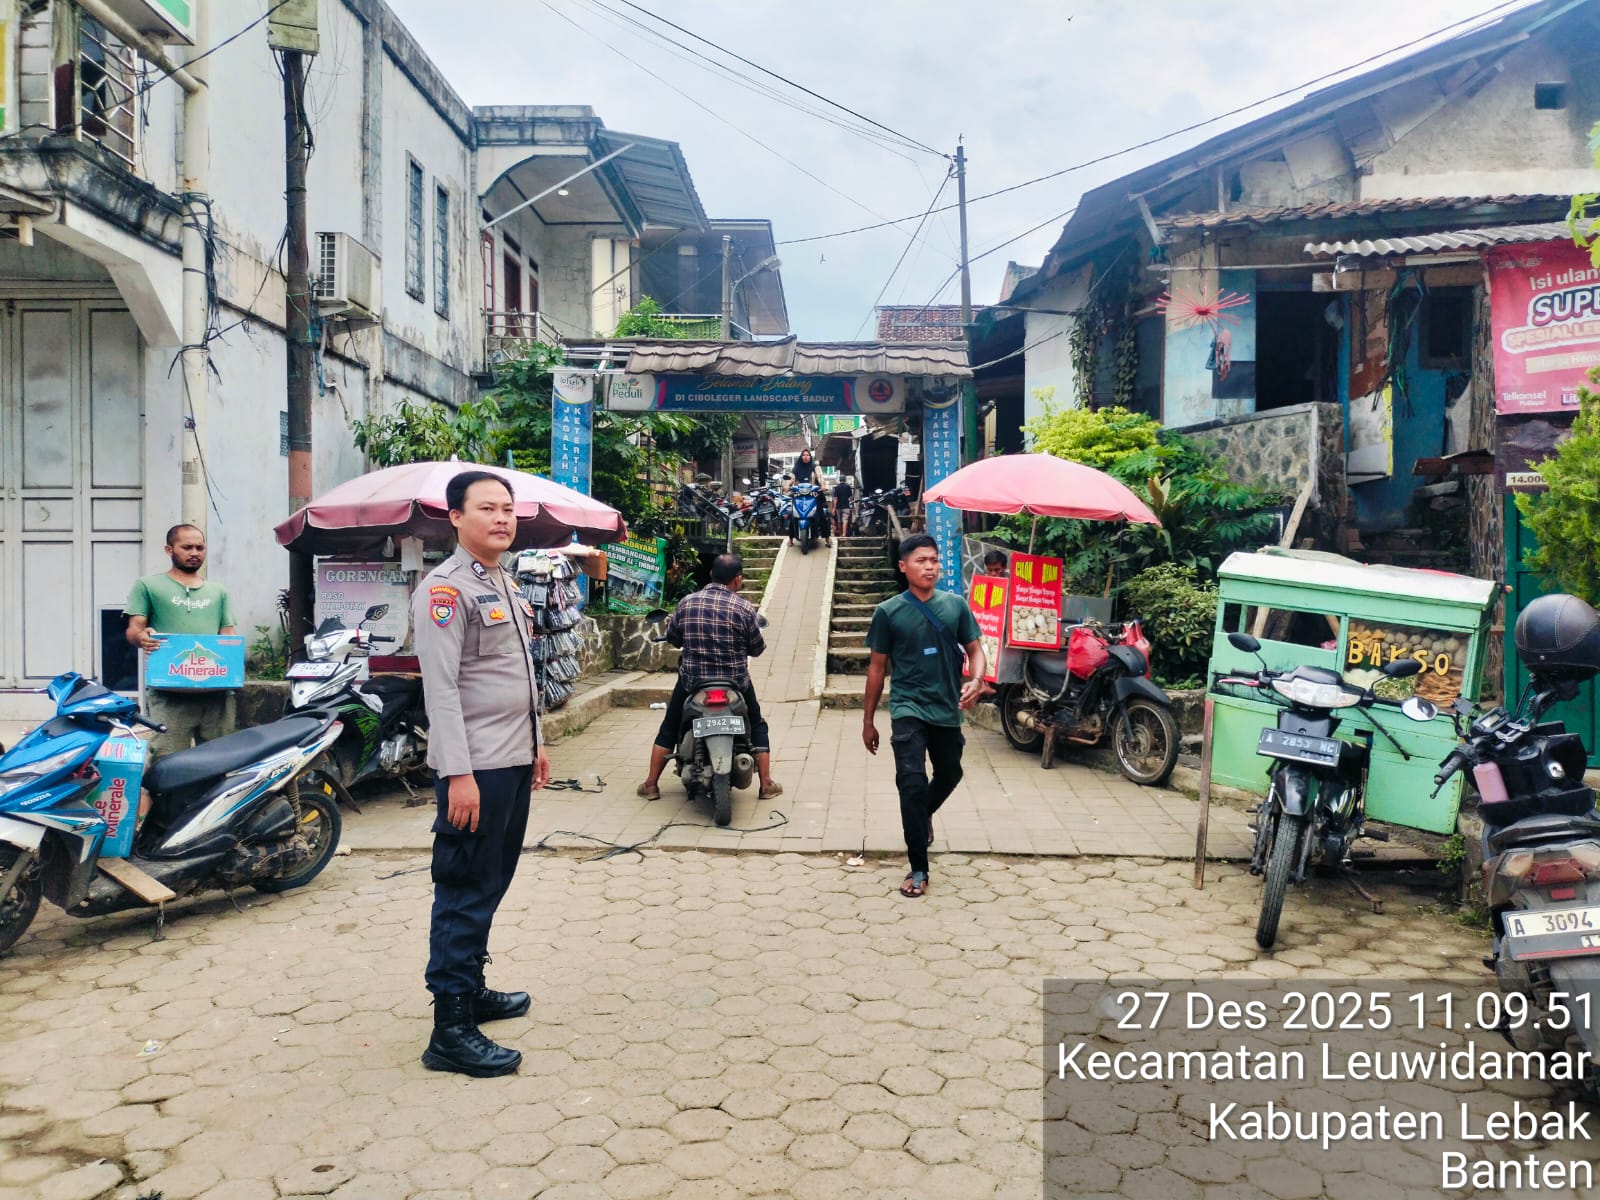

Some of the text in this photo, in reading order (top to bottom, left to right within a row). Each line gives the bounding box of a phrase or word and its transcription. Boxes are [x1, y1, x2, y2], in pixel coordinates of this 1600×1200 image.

[1529, 268, 1600, 291] Isi ulan
[1533, 286, 1600, 326] SUPE
[612, 389, 643, 400] Peduli
[675, 393, 834, 403] DI CIBOLEGER LANDSCAPE BADUY
[1502, 390, 1546, 401] Telkomsel
[1562, 392, 1580, 404] Lit
[561, 406, 570, 471] JAGALAH
[932, 411, 941, 477] JAGALAH
[325, 570, 408, 583] GORENGAN
[190, 652, 207, 666] Le
[1347, 639, 1450, 677] BAKSO
[168, 663, 228, 677] Minerale
[1265, 732, 1273, 743] A
[105, 778, 126, 838] Minerale
[1513, 911, 1593, 936] A 3094
